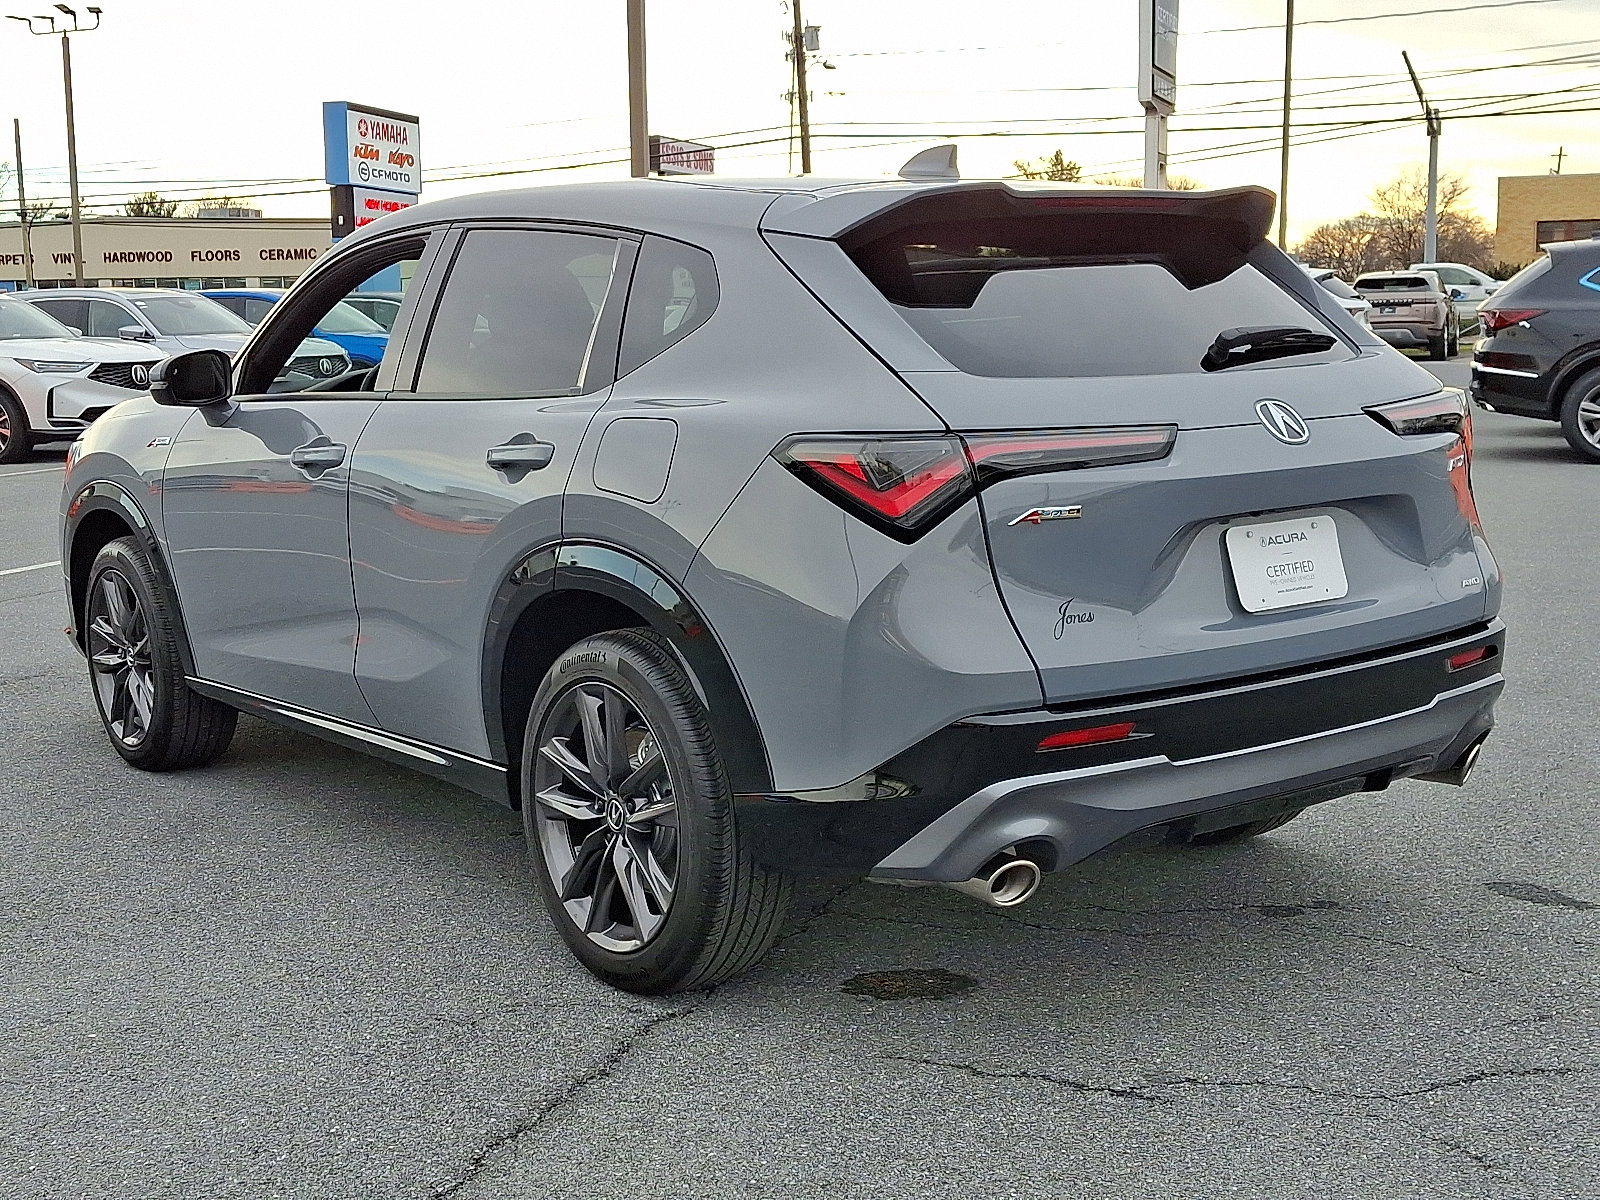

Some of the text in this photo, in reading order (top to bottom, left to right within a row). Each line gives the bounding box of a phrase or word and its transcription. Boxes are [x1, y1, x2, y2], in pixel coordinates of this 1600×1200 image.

[369, 119, 408, 145] YAMAHA
[353, 142, 380, 161] KTM
[693, 151, 714, 172] SONS
[371, 168, 410, 183] CFMOTO
[51, 252, 86, 264] VIN
[103, 251, 173, 263] HARDWOOD
[190, 249, 240, 261] FLOORS
[259, 248, 317, 260] CERAMIC
[1267, 531, 1308, 546] ACURA
[1266, 560, 1314, 578] CERTIFIED
[1053, 597, 1095, 640] Jones
[560, 651, 601, 673] Continental
